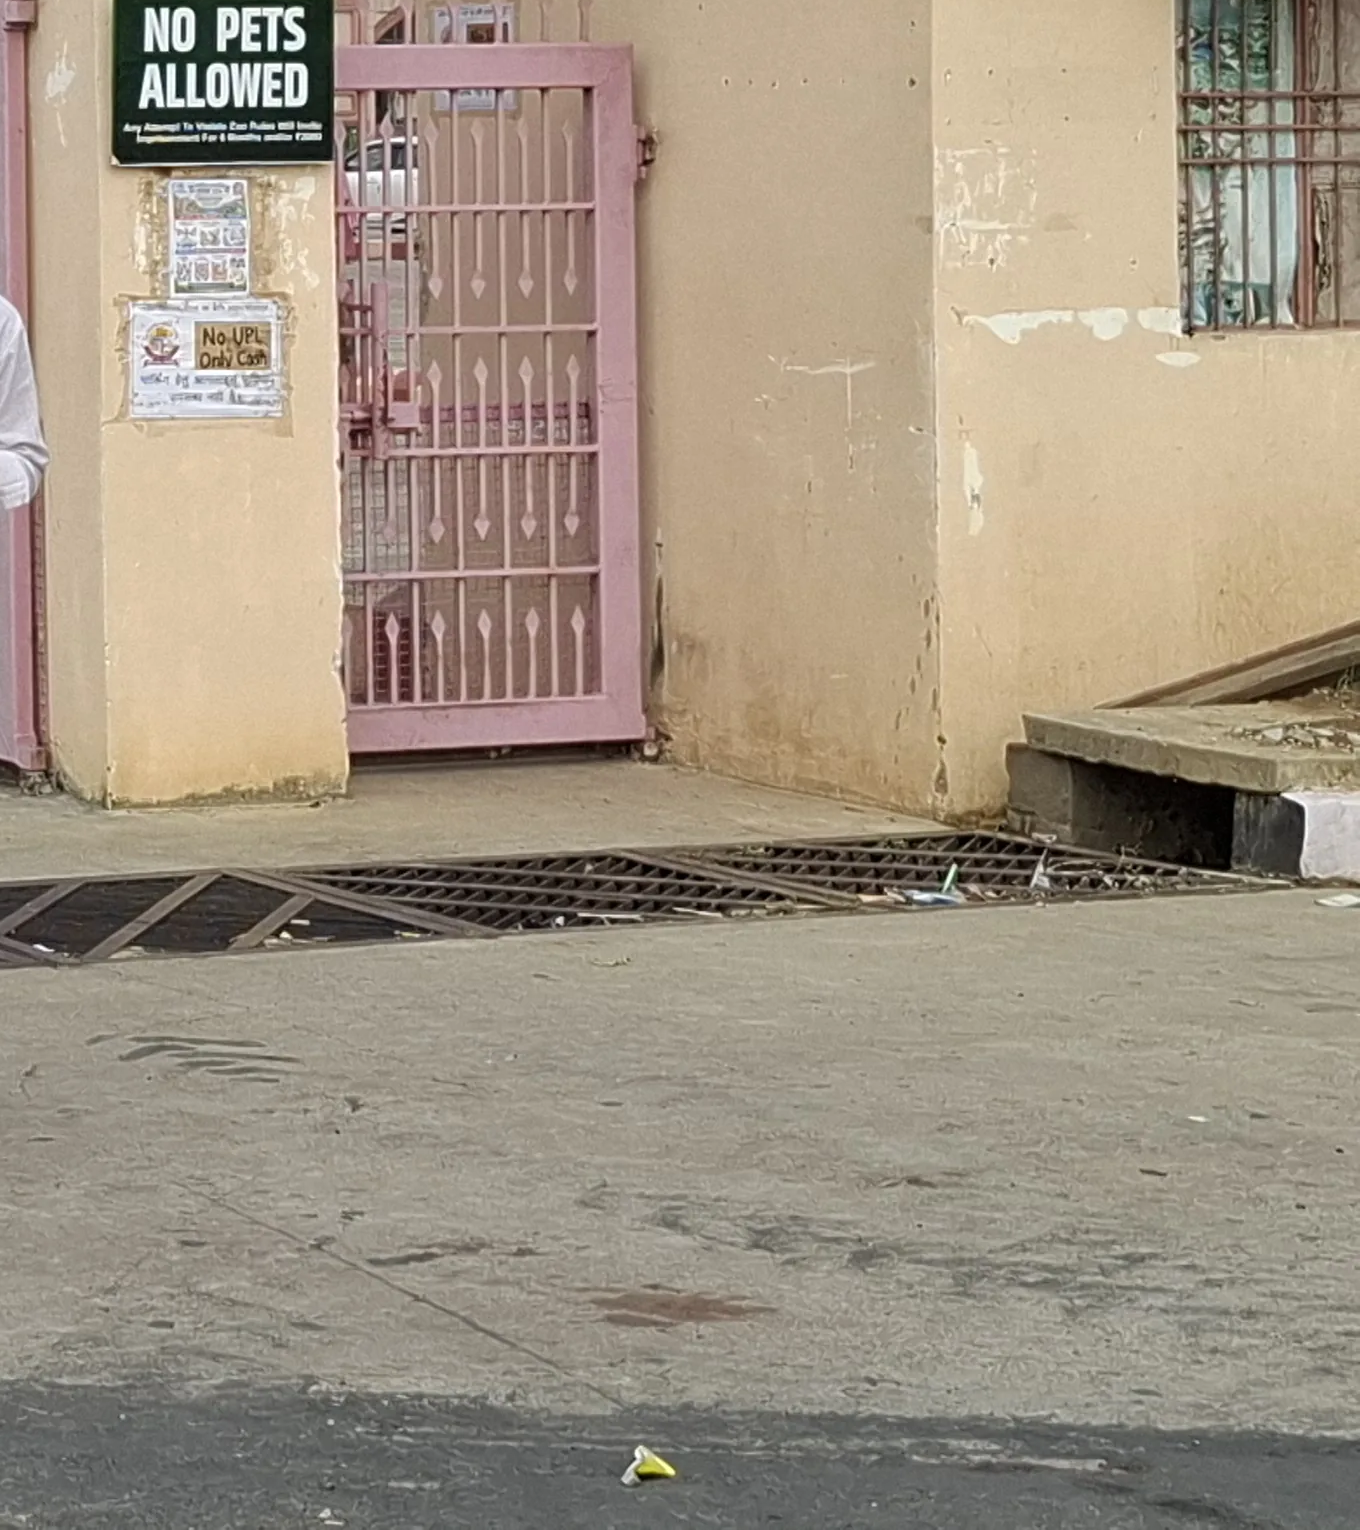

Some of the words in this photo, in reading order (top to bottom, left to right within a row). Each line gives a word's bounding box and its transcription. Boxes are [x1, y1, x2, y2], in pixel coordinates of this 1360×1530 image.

[143, 6, 197, 53] NO
[216, 6, 307, 53] PETS
[138, 62, 309, 110] ALLOWED
[203, 326, 226, 346] No
[200, 349, 233, 369] Only
